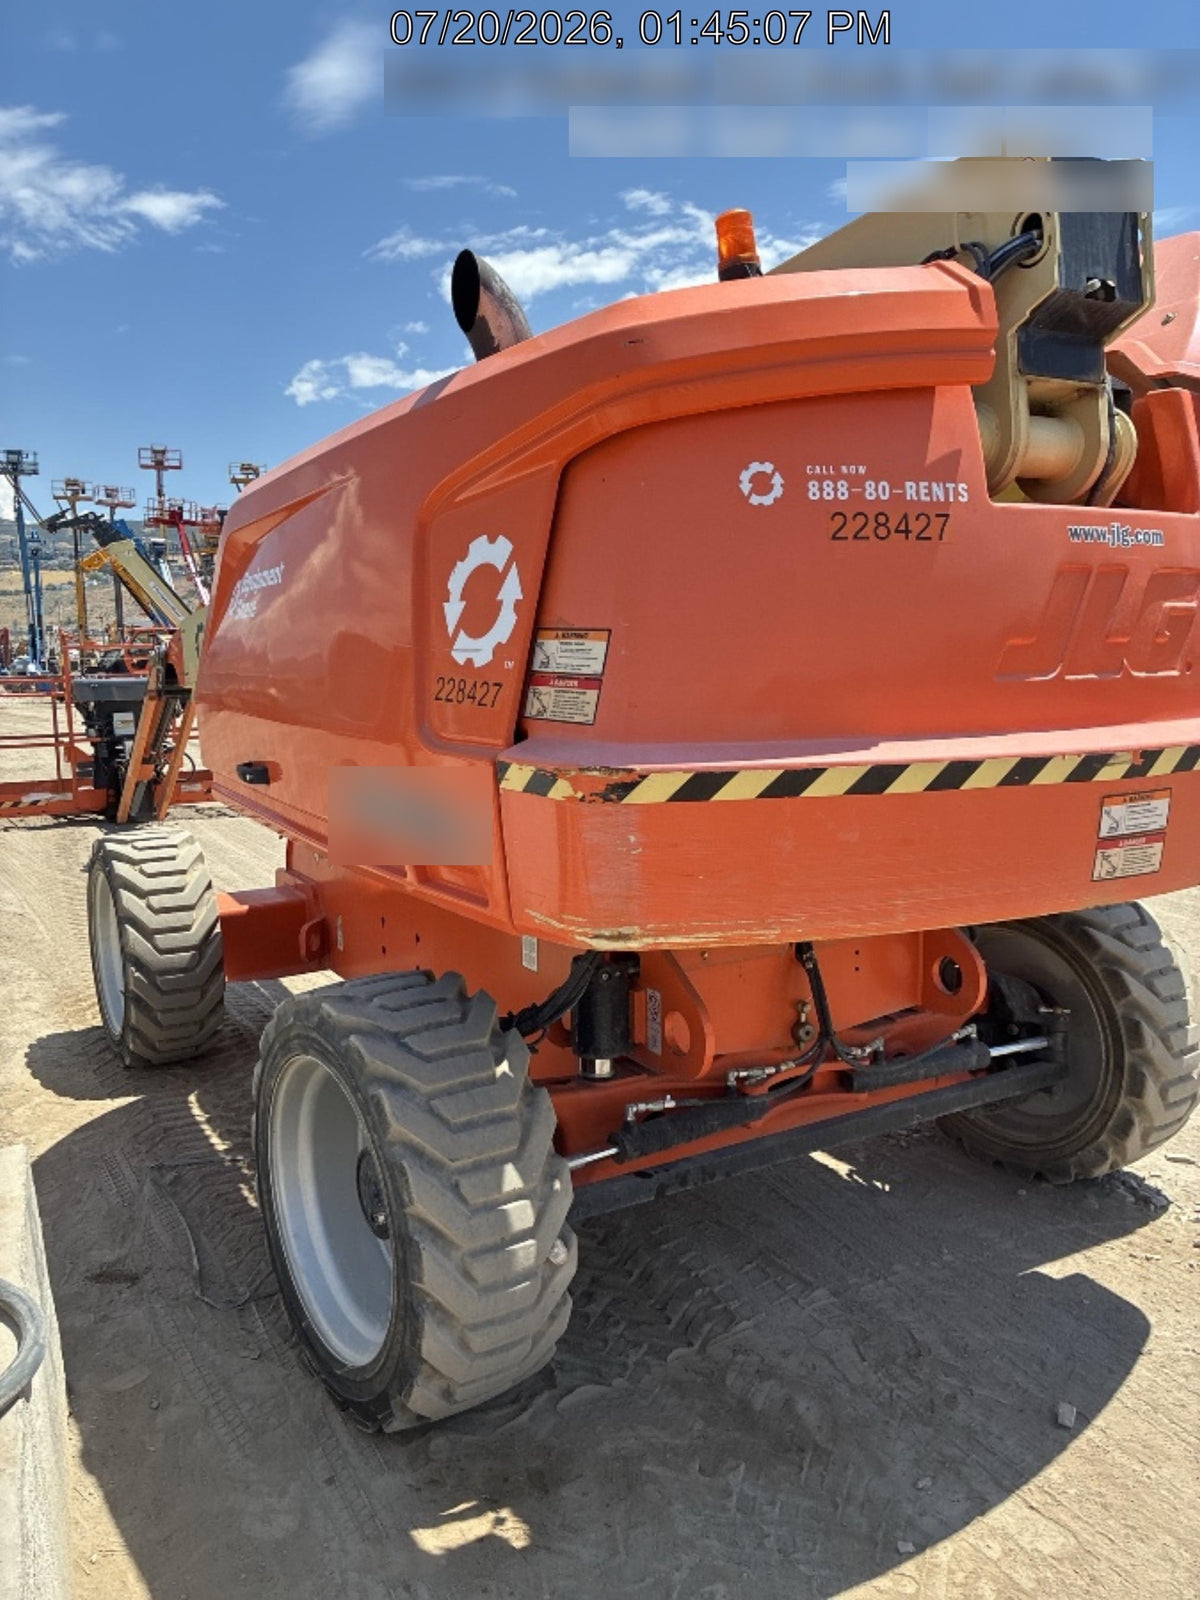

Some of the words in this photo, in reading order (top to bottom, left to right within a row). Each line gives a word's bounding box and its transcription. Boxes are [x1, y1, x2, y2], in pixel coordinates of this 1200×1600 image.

[806, 465, 836, 475] CALL
[841, 465, 867, 476] NOW
[807, 480, 969, 503] 888-80-RENTS
[830, 511, 951, 541] 228427
[1067, 523, 1165, 548] www.jlg.com
[434, 676, 503, 708] 228427
